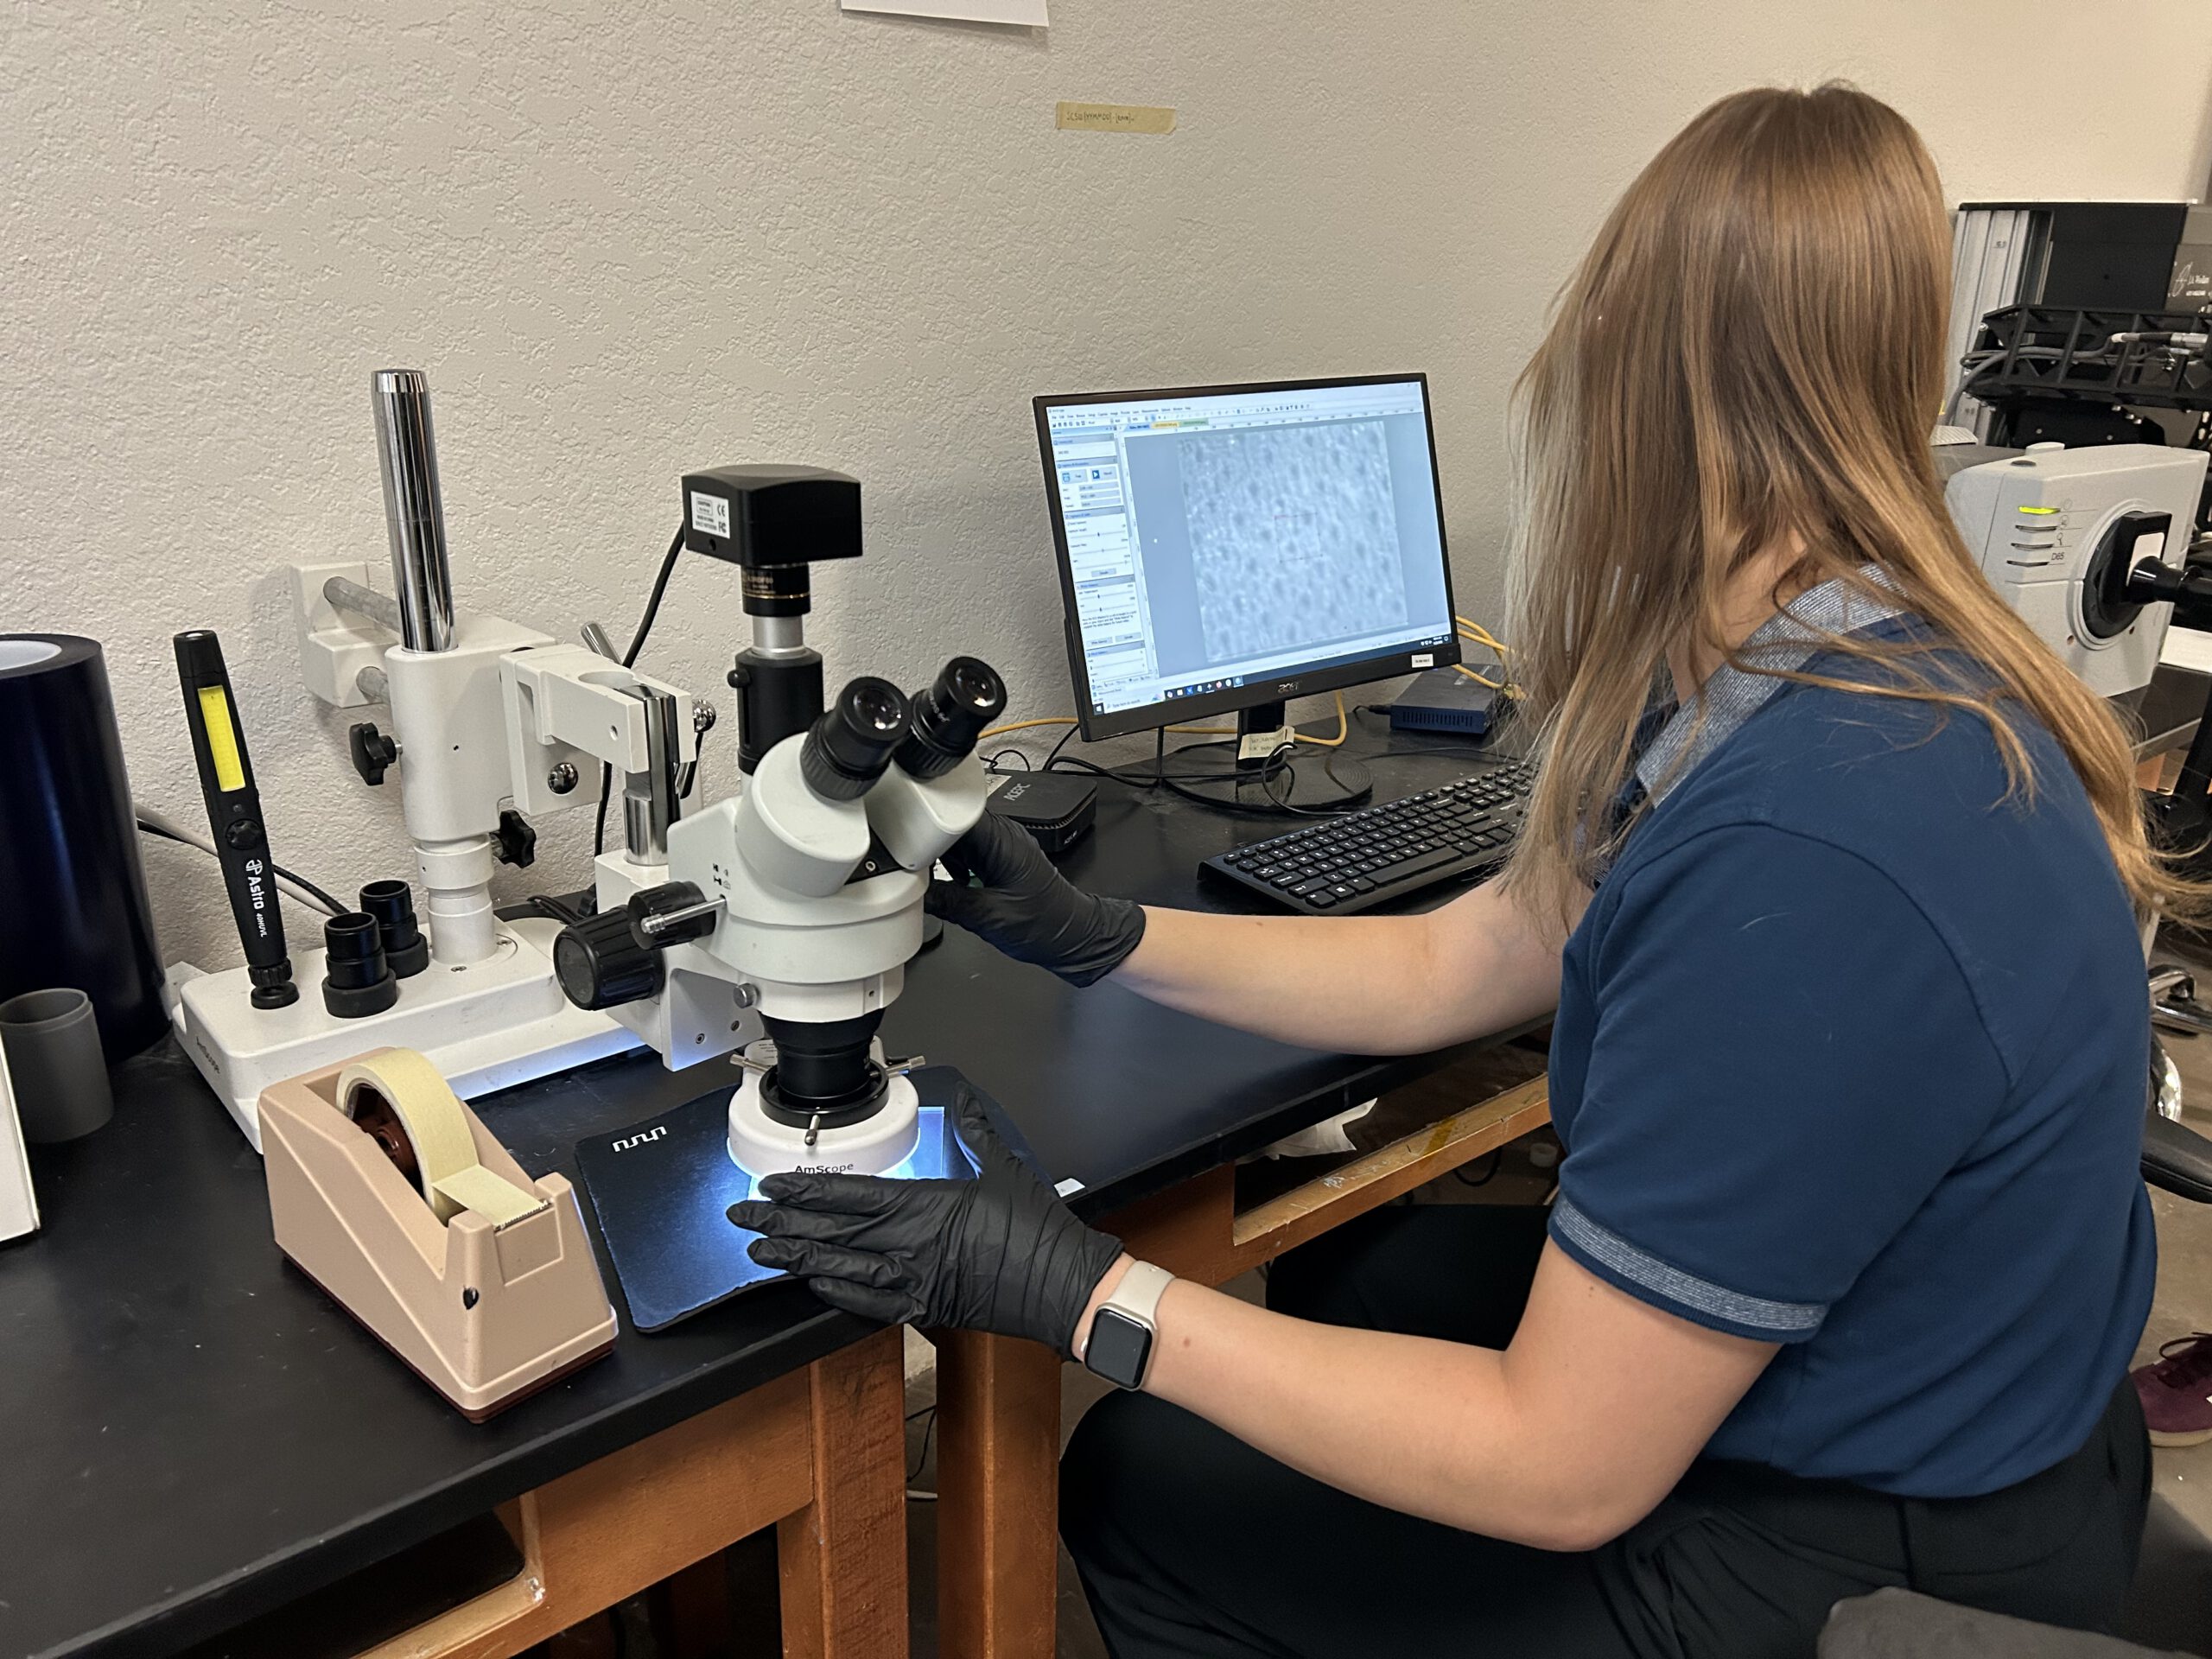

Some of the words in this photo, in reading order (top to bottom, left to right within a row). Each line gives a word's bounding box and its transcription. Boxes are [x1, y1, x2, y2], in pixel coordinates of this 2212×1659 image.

[2051, 552, 2065, 561] D65
[1003, 783, 1032, 801] ACEPC
[247, 876, 265, 910] Astro
[795, 1163, 854, 1174] AmScope
